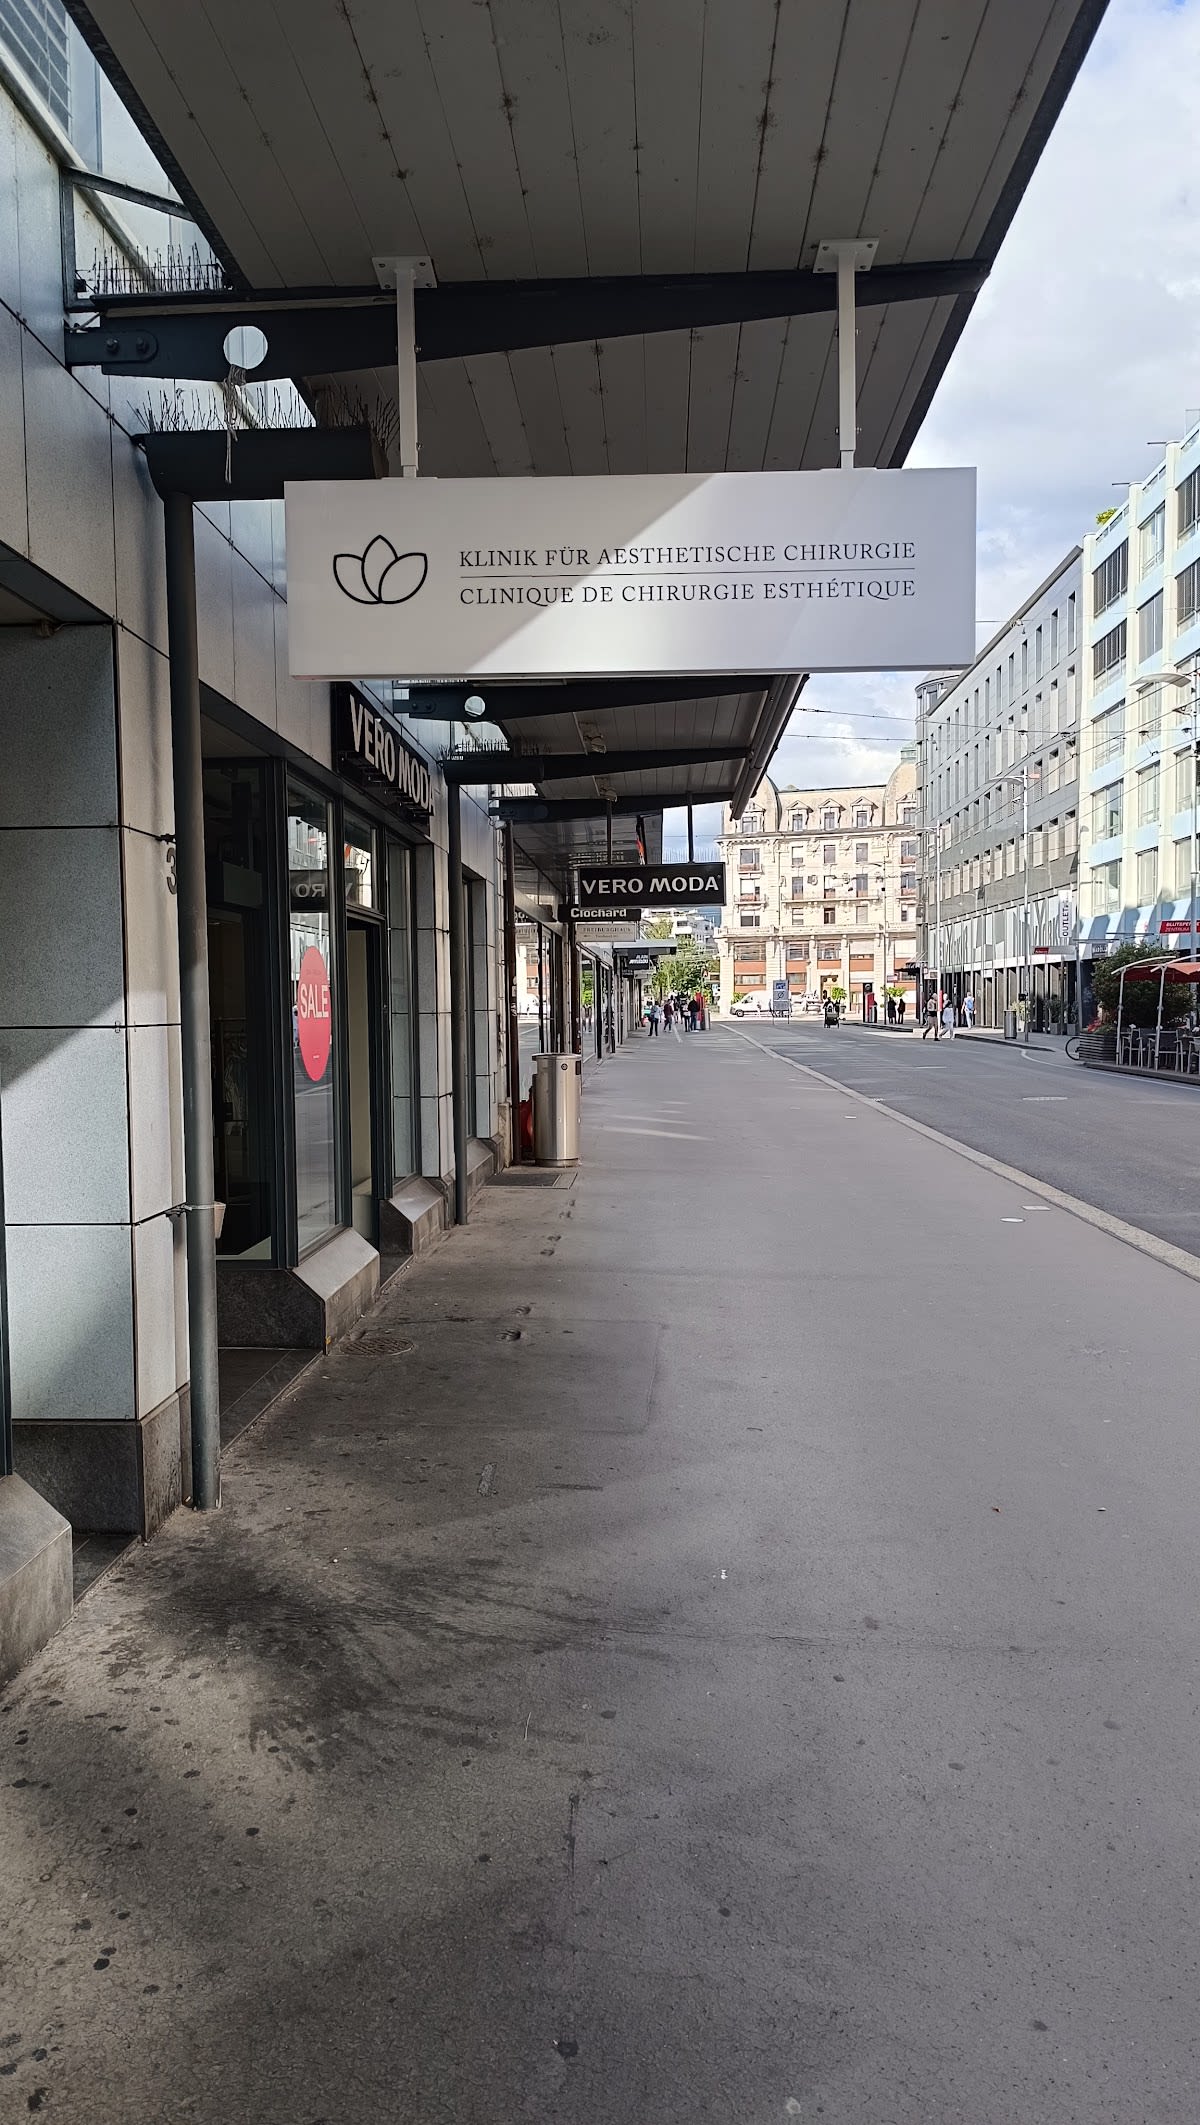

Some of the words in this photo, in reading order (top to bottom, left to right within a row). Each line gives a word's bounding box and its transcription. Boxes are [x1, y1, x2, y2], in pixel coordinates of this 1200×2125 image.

[460, 549, 538, 567] KLINIK
[545, 546, 590, 566] FÜR
[597, 546, 776, 565] AESTHETISCHE
[783, 542, 915, 561] CHIRURGIE
[460, 587, 574, 607] CLINIQUE
[582, 585, 613, 603] DE
[621, 583, 754, 601] CHIRURGIE
[764, 578, 915, 600] ESTHÉTIQUE
[350, 694, 396, 782] VERO
[398, 744, 436, 817] MODA
[582, 878, 643, 895] VERO
[649, 876, 719, 893] MODA
[570, 907, 627, 918] Clochard
[301, 983, 329, 1019] SALE
